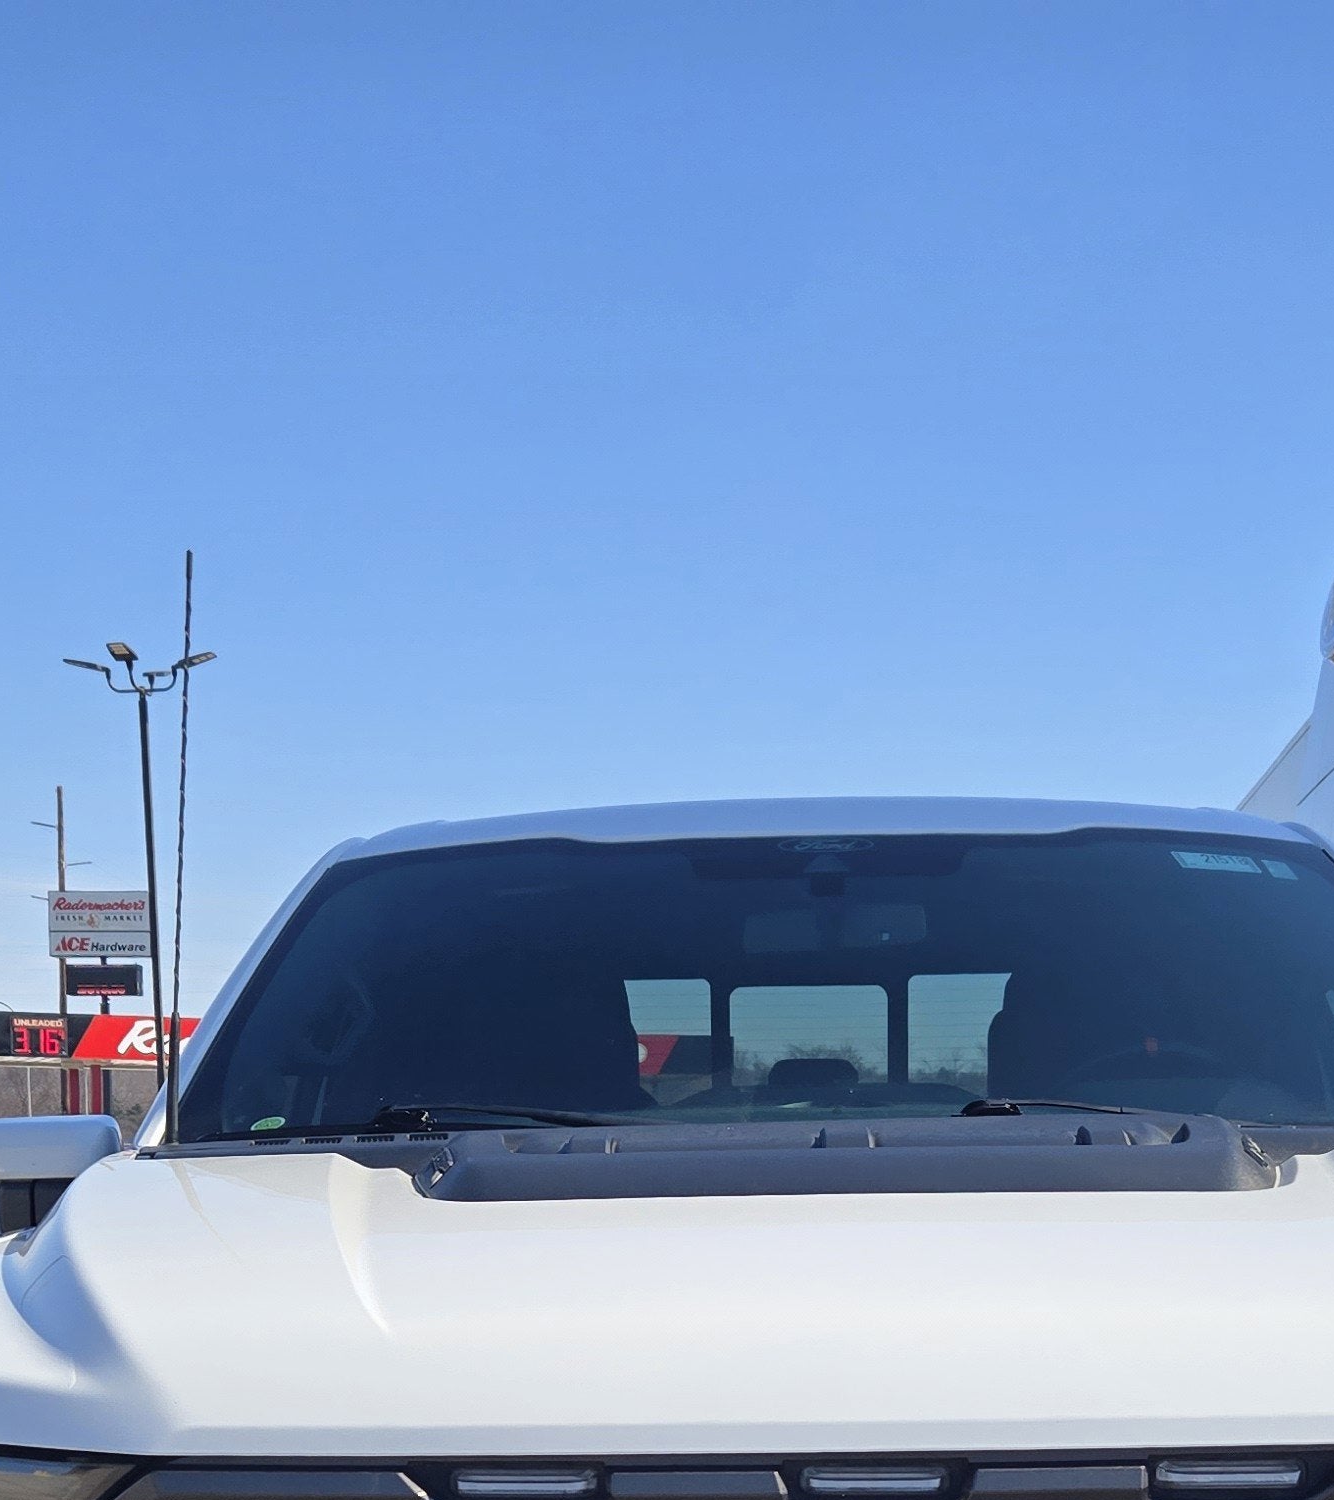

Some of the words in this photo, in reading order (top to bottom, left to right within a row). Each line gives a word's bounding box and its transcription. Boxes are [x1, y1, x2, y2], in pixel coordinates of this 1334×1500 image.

[55, 935, 91, 952] ACE
[91, 942, 146, 952] Hardware
[13, 1018, 64, 1027] UNLEADED
